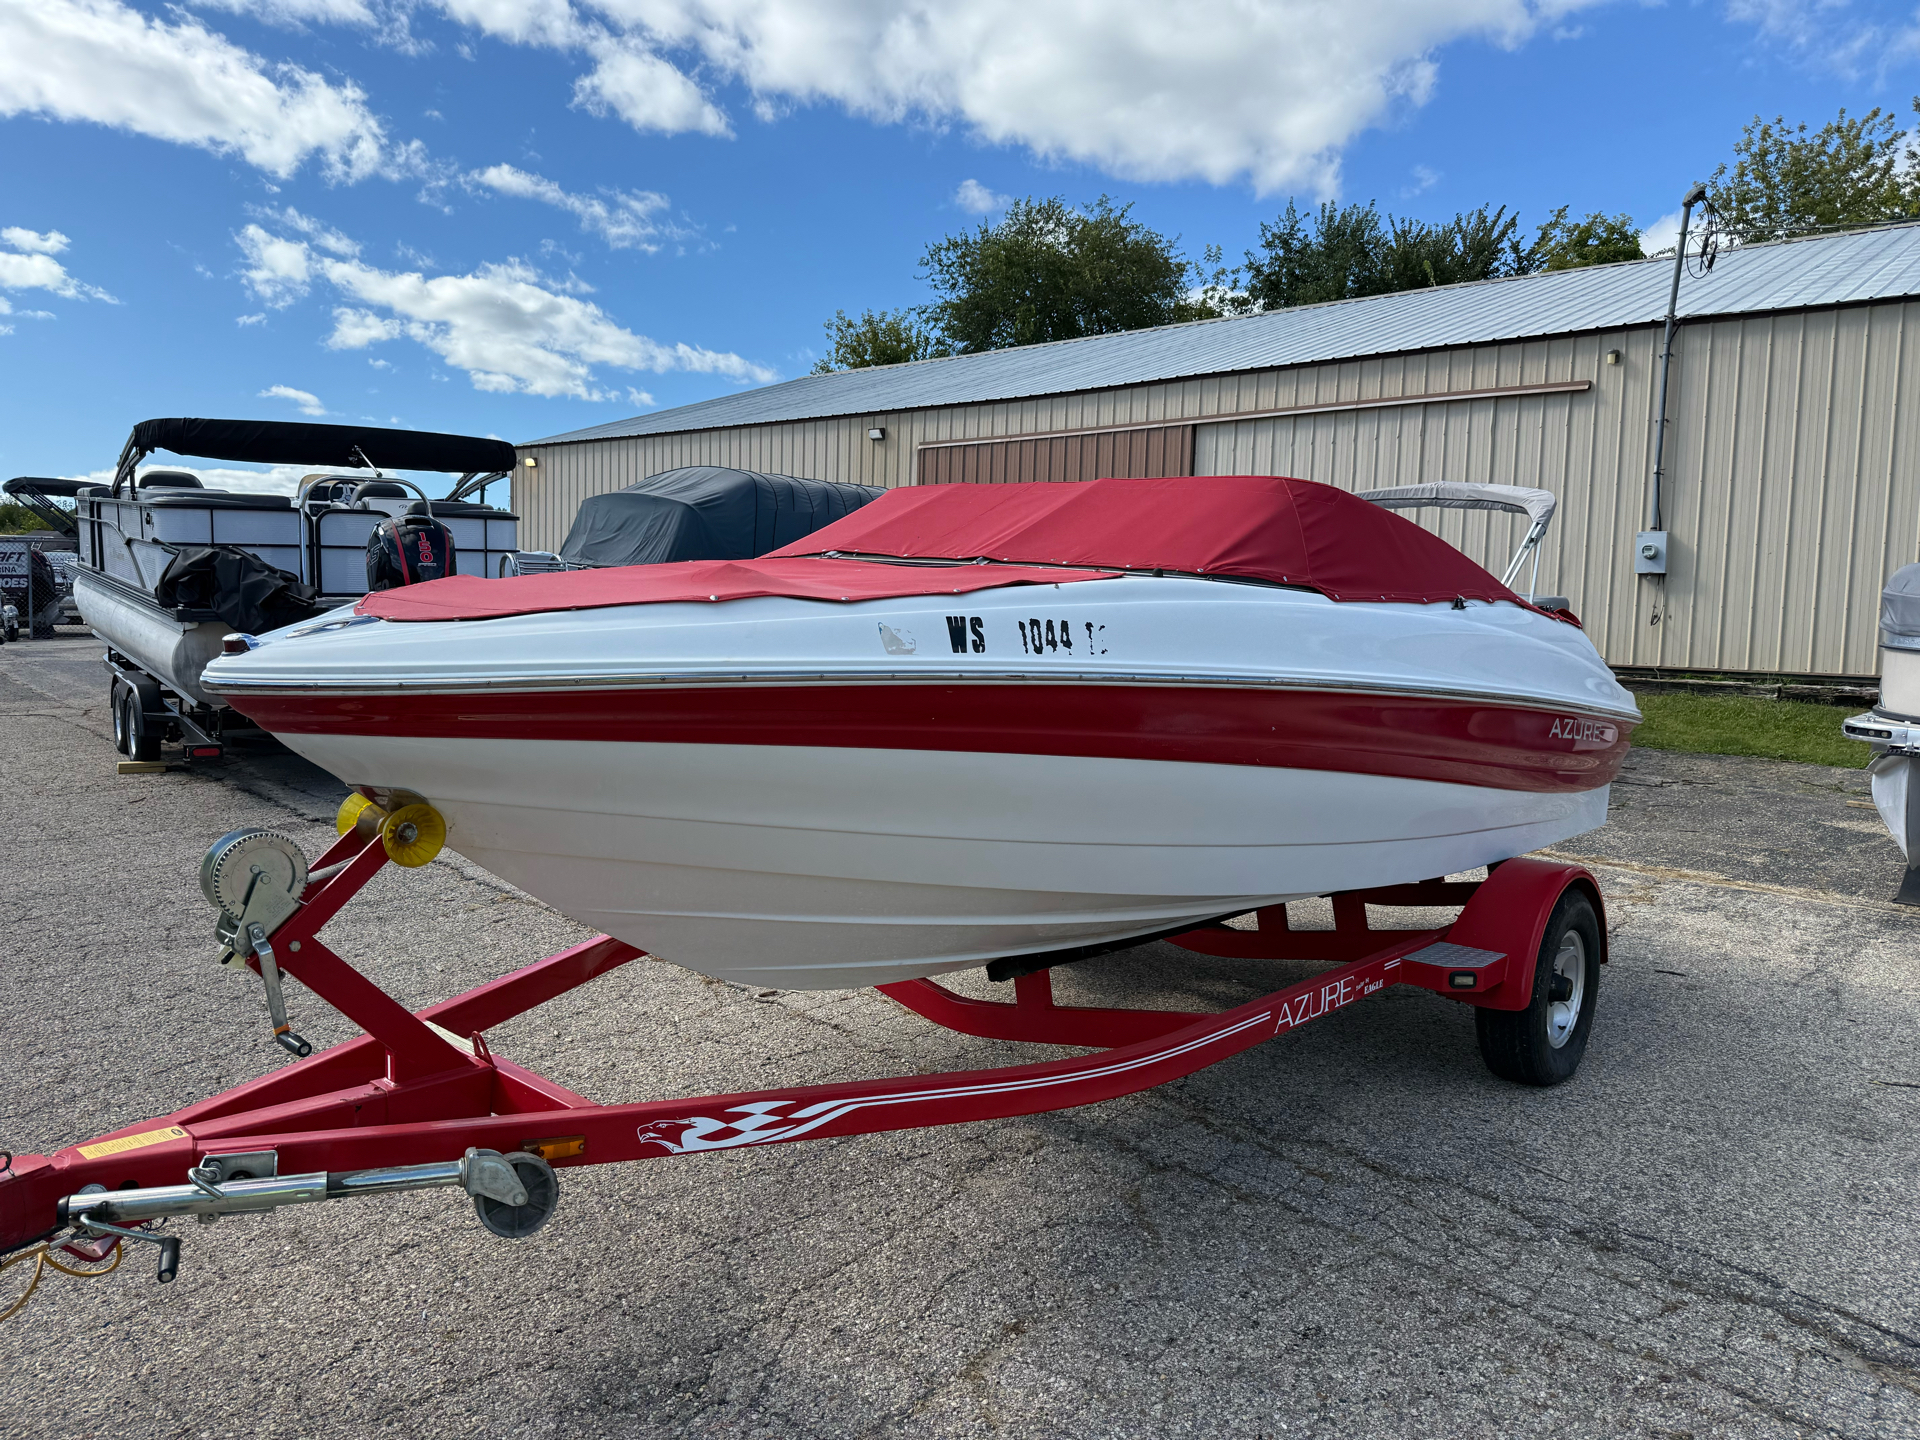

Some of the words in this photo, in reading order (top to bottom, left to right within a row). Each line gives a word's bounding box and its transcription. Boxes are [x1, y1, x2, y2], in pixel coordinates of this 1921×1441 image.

[418, 531, 434, 563] 150
[945, 616, 986, 654] WS
[1018, 618, 1073, 656] 1044
[1548, 717, 1602, 742] AZURE
[1364, 978, 1384, 995] EAGLE
[1274, 975, 1355, 1034] AZURE
